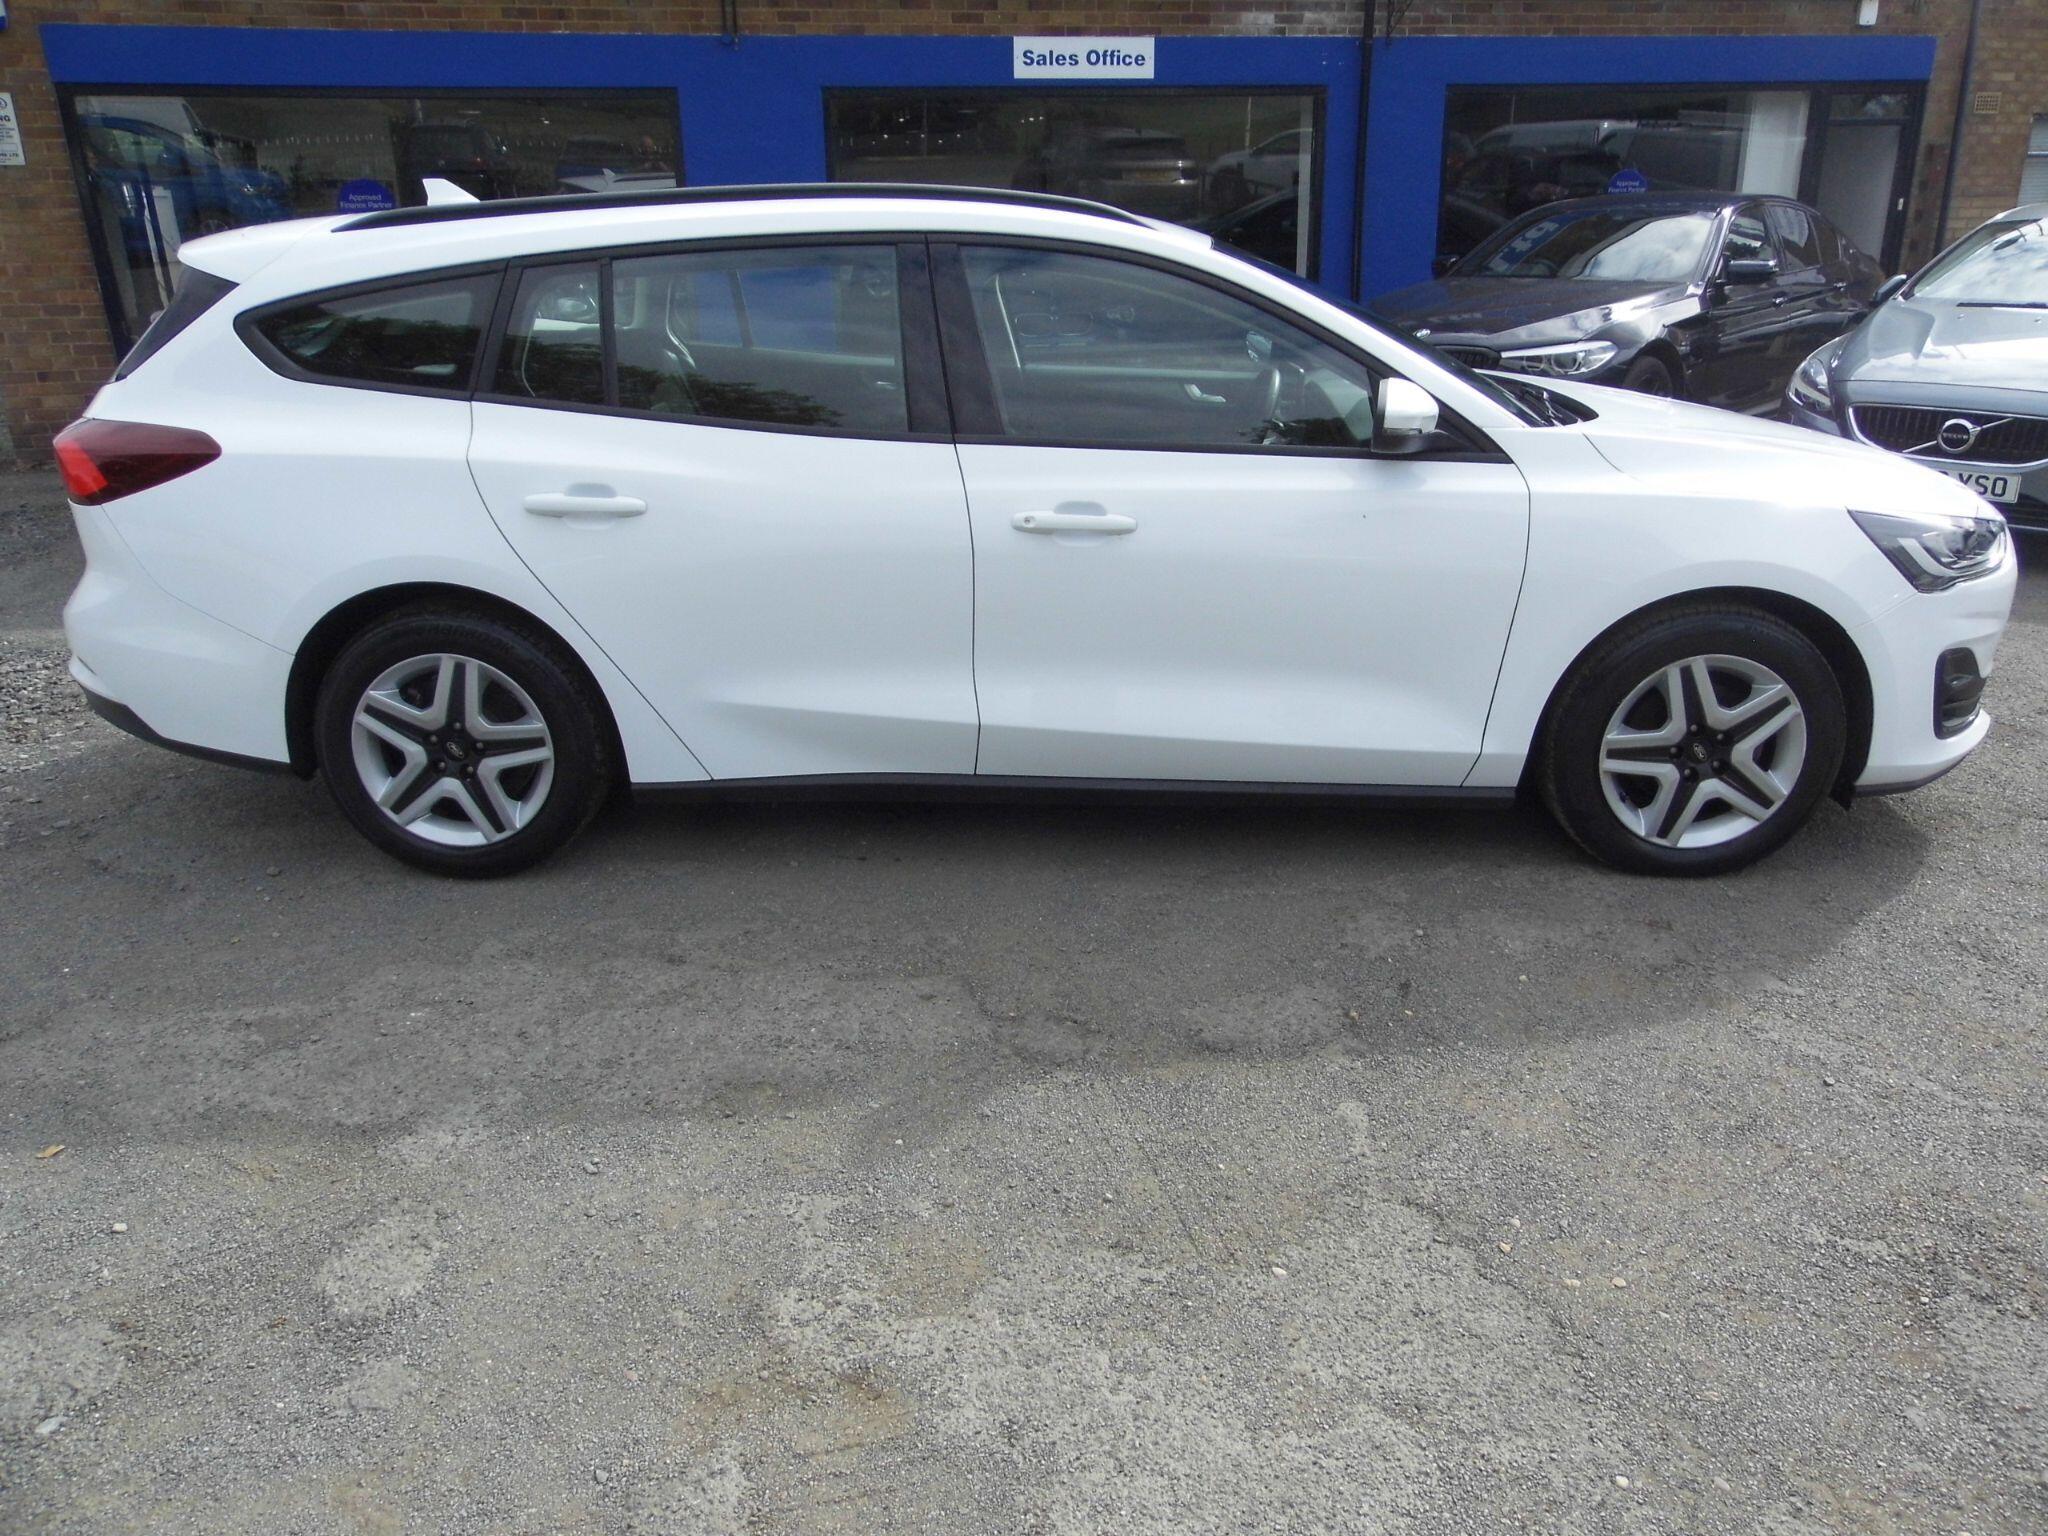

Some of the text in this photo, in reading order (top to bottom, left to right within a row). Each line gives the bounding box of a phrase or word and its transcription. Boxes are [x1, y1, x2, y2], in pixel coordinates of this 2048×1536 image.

[1022, 49, 1146, 66] Sales Office
[348, 193, 382, 202] Approved
[339, 201, 367, 209] Finance
